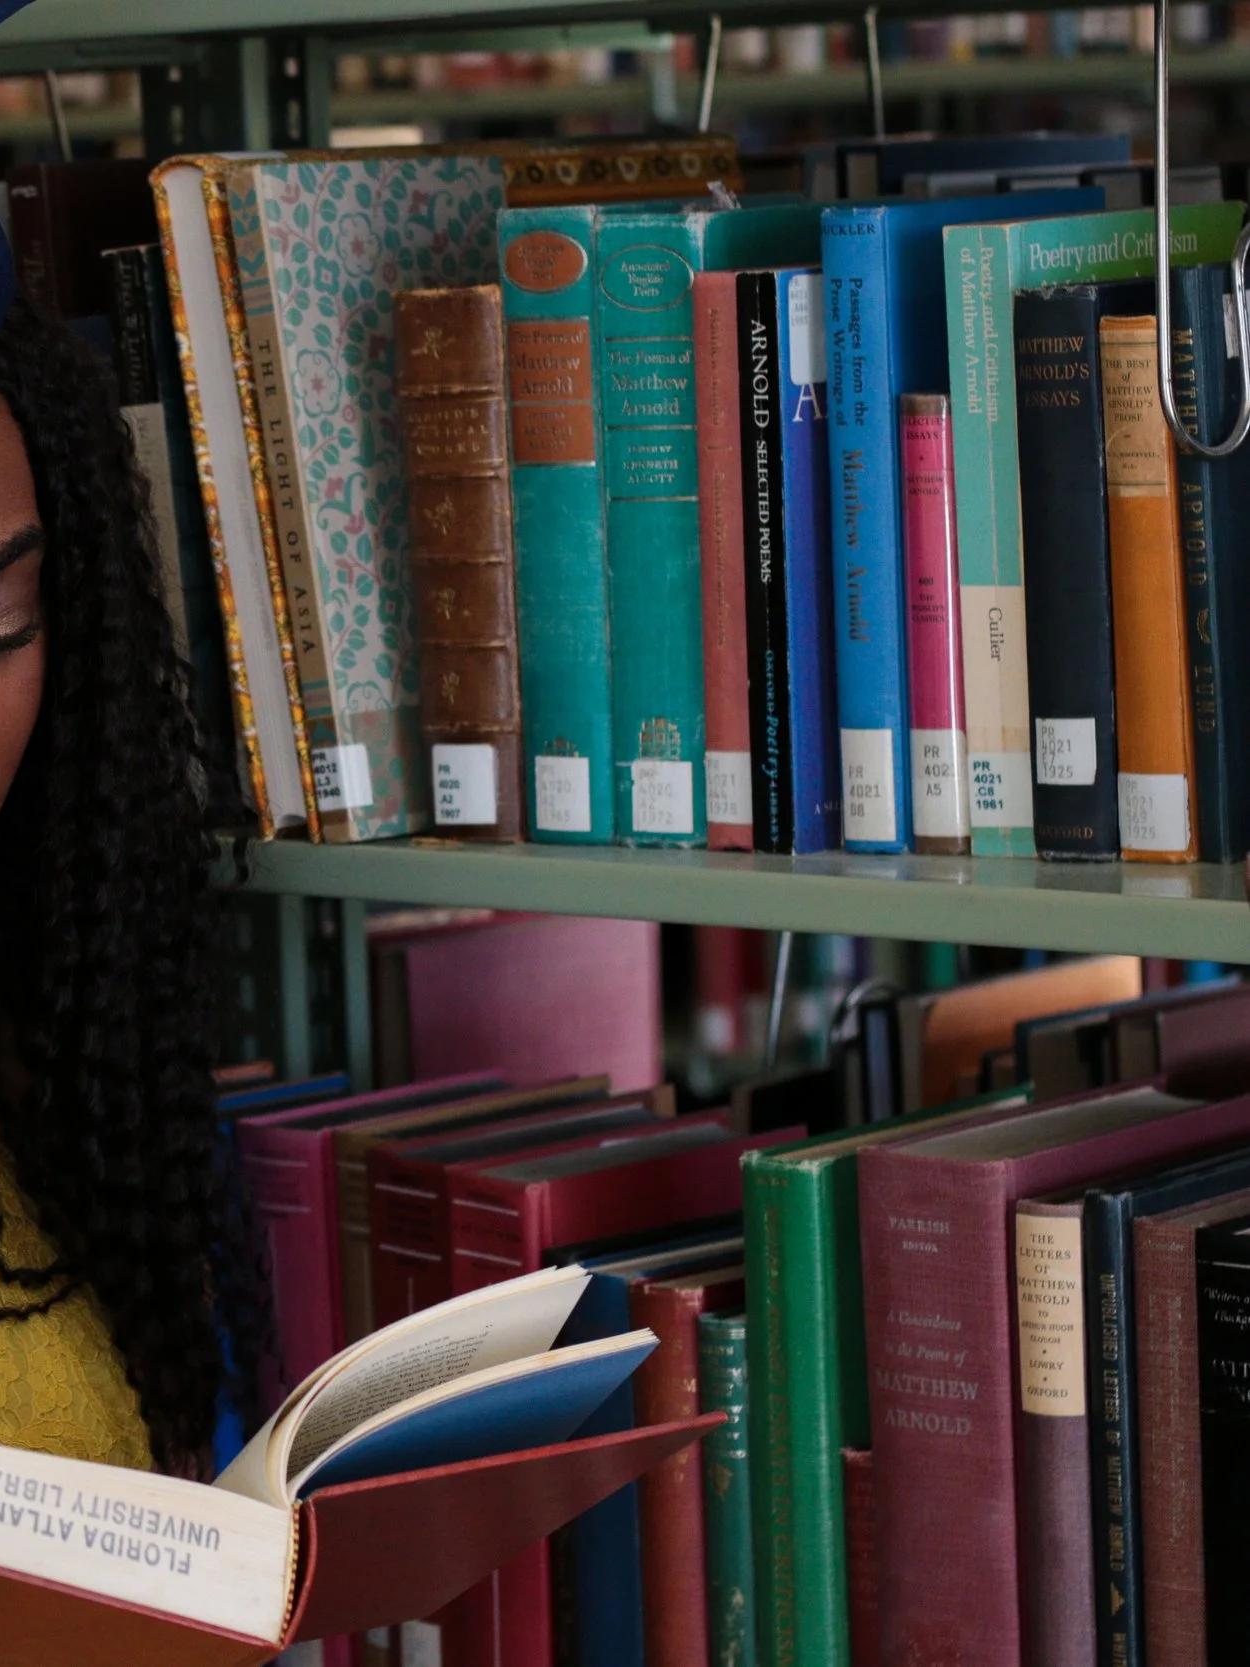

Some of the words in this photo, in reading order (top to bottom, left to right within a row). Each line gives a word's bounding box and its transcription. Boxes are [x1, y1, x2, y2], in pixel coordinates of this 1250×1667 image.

[821, 222, 877, 236] UCKLER
[960, 248, 974, 264] of
[1030, 241, 1085, 272] Poetry
[1088, 232, 1118, 262] and
[1121, 230, 1198, 260] Critism
[980, 247, 995, 302] Poetry
[634, 285, 660, 297] Poets
[830, 277, 842, 322] Prose
[848, 277, 864, 350] Passages
[961, 269, 977, 352] Matthew
[982, 306, 996, 342] and
[1018, 336, 1084, 352] MATTHEW
[515, 352, 581, 370] Matthew
[607, 351, 632, 365] The
[634, 351, 676, 366] Poems
[678, 351, 693, 364] of
[1106, 360, 1123, 368] THE
[1126, 359, 1151, 368] BEST
[751, 319, 770, 429] ARNOLD
[852, 356, 867, 394] from
[1018, 363, 1090, 381] ARNOLD'S
[1121, 371, 1131, 382] of
[521, 376, 574, 395] Arnold
[612, 371, 688, 391] Matthew
[965, 355, 983, 415] Arnold
[983, 344, 999, 423] Criticism
[1024, 390, 1081, 407] ESSAYS
[1106, 386, 1153, 396] MATTHEW
[1174, 328, 1198, 455] MATTHE
[621, 398, 681, 415] Arnold
[1107, 399, 1154, 409] ARNOLD'S
[854, 402, 868, 427] the
[1114, 413, 1144, 422] PROSE
[756, 440, 770, 522] SELECTED
[258, 339, 278, 397] THE
[269, 418, 295, 510] LIGHT
[286, 531, 301, 563] OF
[295, 586, 316, 653] ASIA
[843, 450, 865, 549] Matthew
[759, 528, 772, 583] POEMS
[846, 562, 870, 642] Arnold
[988, 606, 1004, 661] Culler
[762, 715, 779, 778] Poetry
[924, 744, 940, 758] PR
[1041, 740, 1072, 753] 4021
[848, 765, 864, 778] PR
[973, 760, 991, 771] PR
[1043, 766, 1074, 779] 1925
[974, 774, 1002, 783] 4021
[849, 785, 882, 798] 4021
[926, 783, 943, 797] A5
[976, 799, 1004, 810] 1961
[1127, 825, 1156, 840] 1925
[889, 1216, 951, 1235] PARRISH
[1030, 1234, 1054, 1245] THE
[1019, 1246, 1072, 1260] LETTERS
[1035, 1264, 1051, 1273] OF
[1018, 1280, 1076, 1290] MATTHEW
[1021, 1292, 1070, 1305] ARNOLD
[899, 1310, 962, 1331] Concordance
[1038, 1310, 1049, 1318] TO
[1100, 1274, 1118, 1361] UNPUBLISHED
[1049, 1323, 1074, 1332] HUGH
[1029, 1335, 1061, 1345] CLOUGH
[1029, 1360, 1064, 1371] LOWRY
[875, 1370, 979, 1401] MATTHEW
[1027, 1386, 1068, 1398] OXFORD
[1103, 1370, 1120, 1423] LETTERS
[885, 1408, 972, 1436] ARNOLD
[1108, 1456, 1123, 1516] MATTHEW
[72, 1491, 220, 1551] UNIVERSITY
[84, 1525, 192, 1575] FLORIDA
